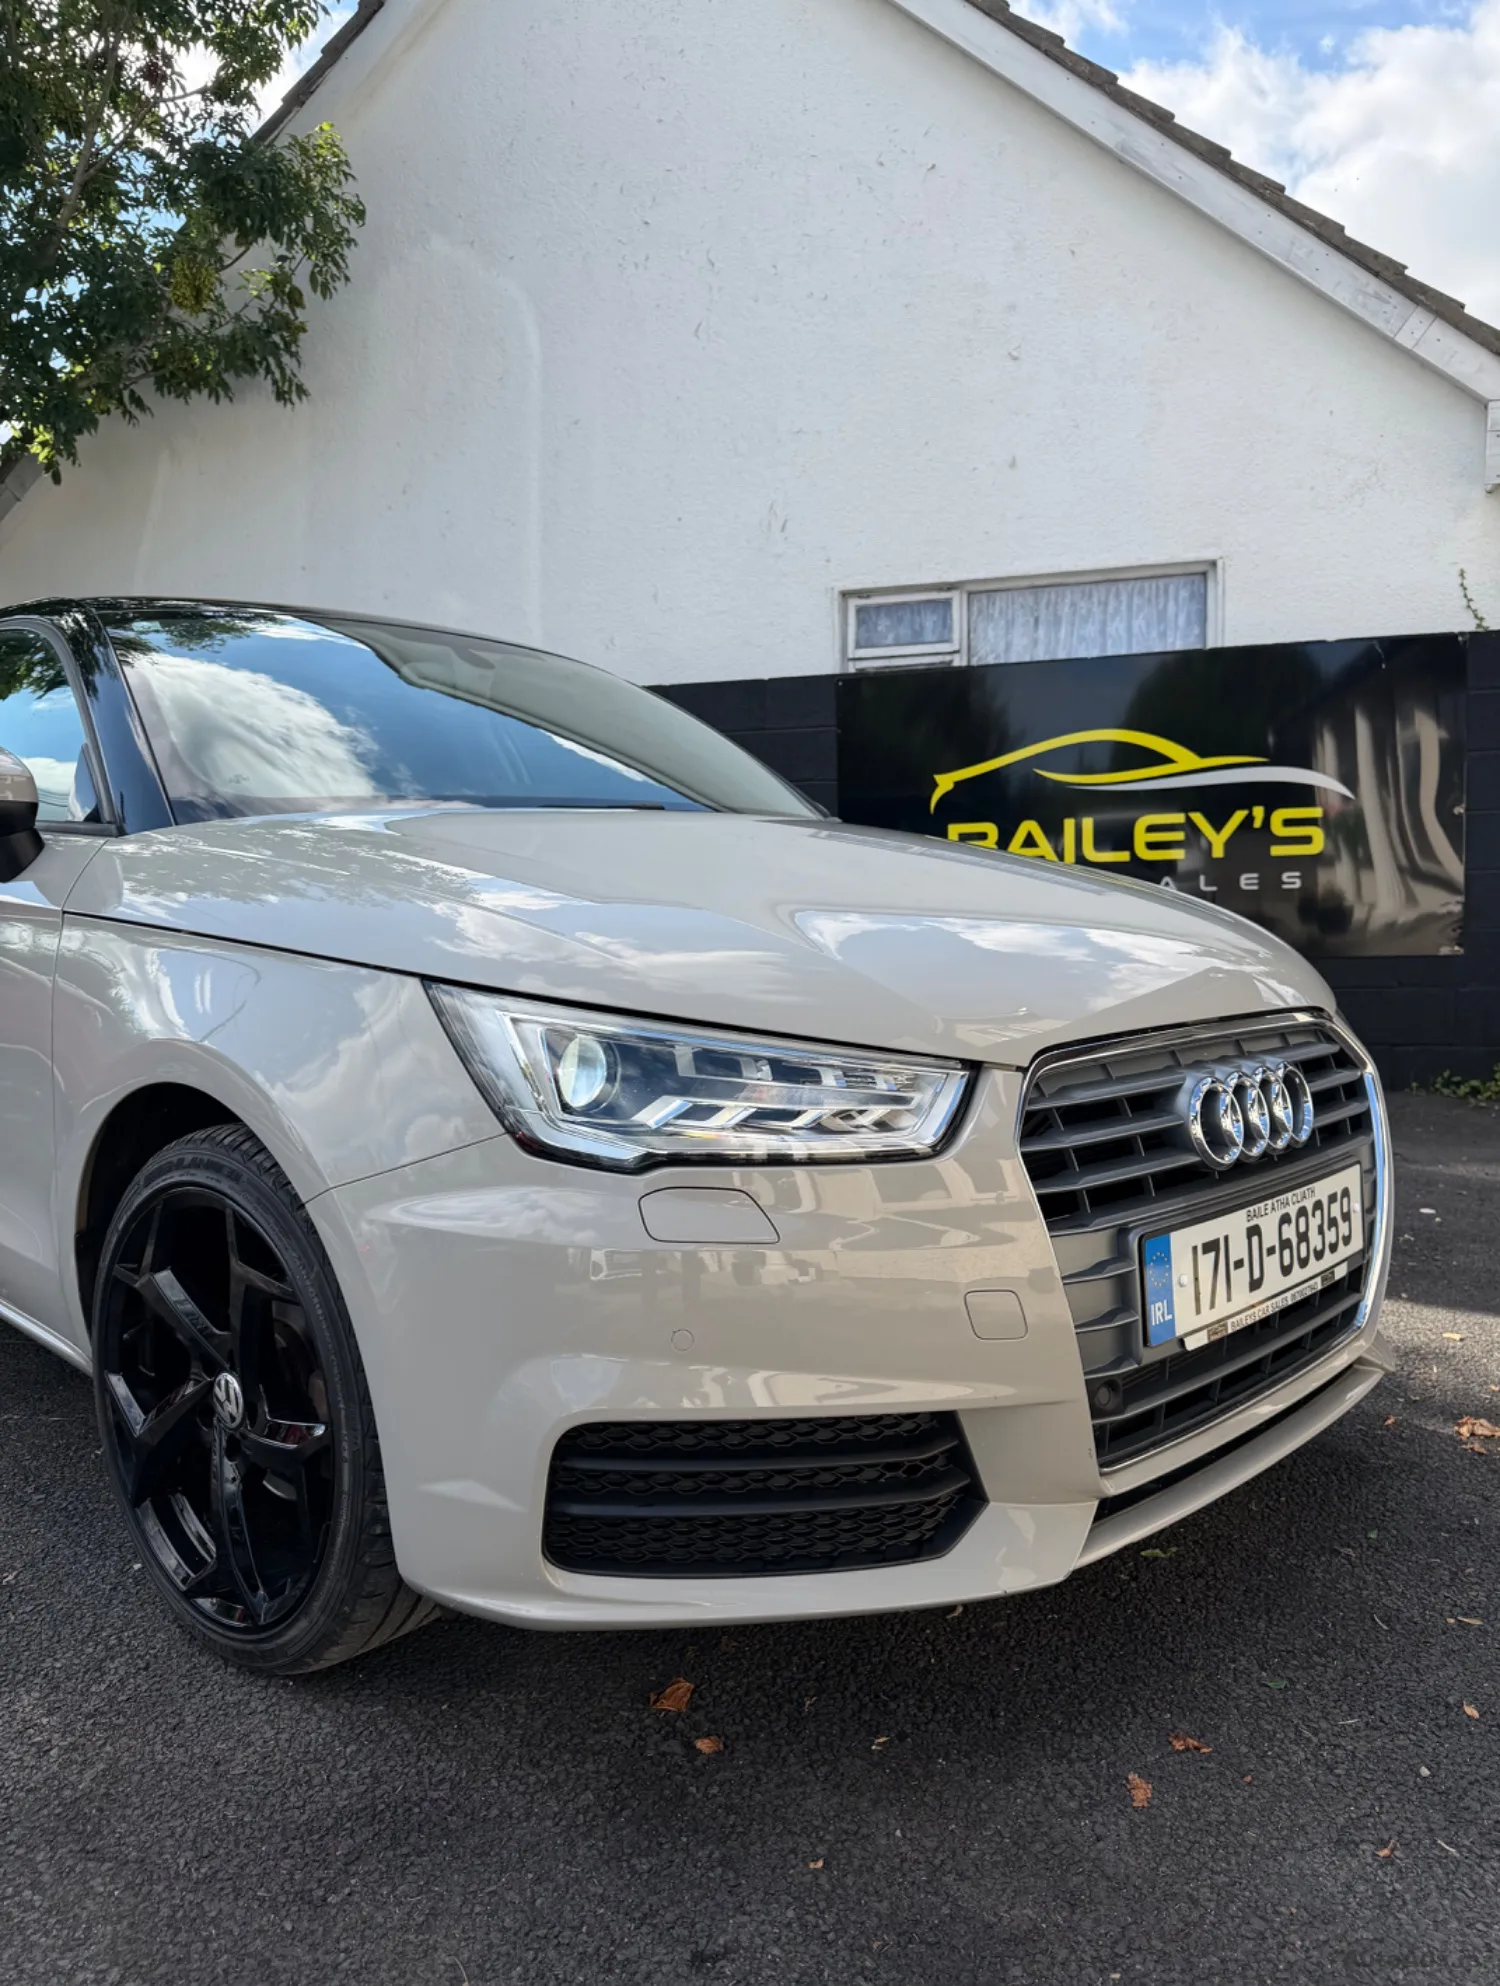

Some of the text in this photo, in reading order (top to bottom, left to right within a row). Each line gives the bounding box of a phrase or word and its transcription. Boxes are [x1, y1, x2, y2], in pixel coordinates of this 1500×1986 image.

[1159, 871, 1303, 892] ALES
[1246, 1202, 1269, 1223] BAILE
[1291, 1187, 1315, 1206] CLIATH
[1191, 1186, 1353, 1316] 171-D-68359
[1150, 1299, 1173, 1327] IRL
[1258, 1305, 1270, 1318] CAR
[1271, 1296, 1288, 1313] SALES
